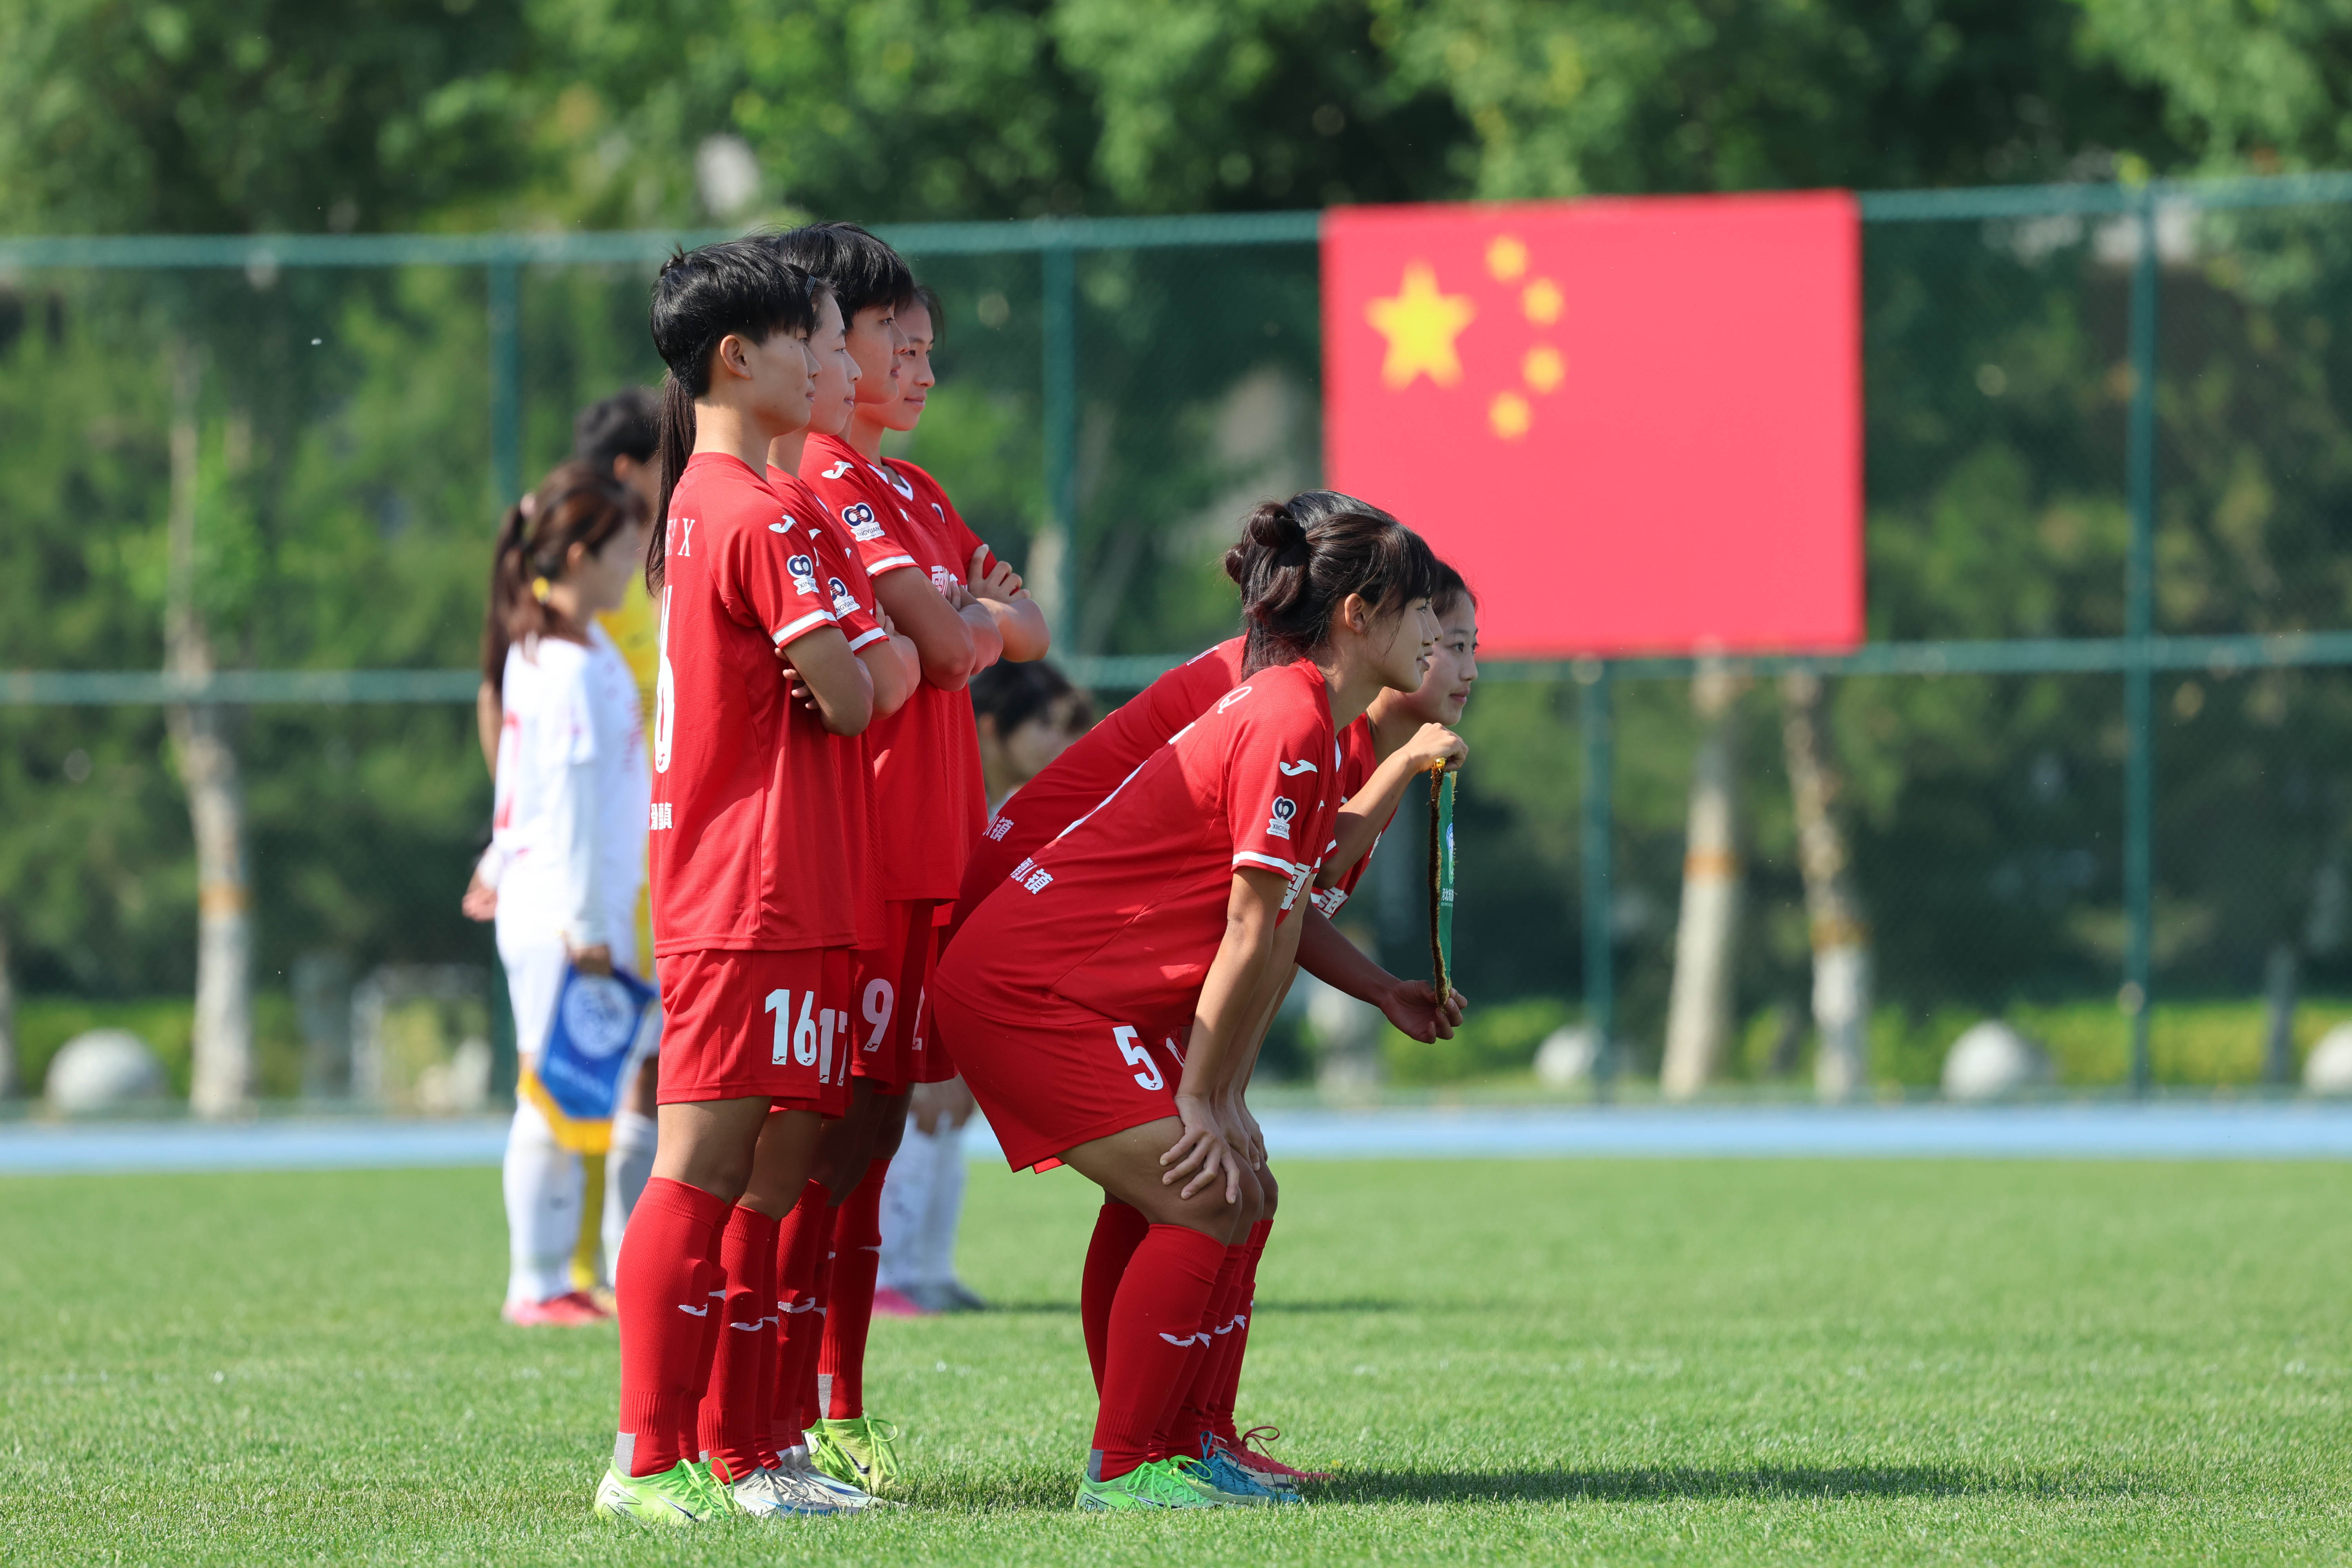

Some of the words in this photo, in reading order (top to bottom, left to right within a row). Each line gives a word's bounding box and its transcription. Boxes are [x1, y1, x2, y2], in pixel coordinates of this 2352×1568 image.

[765, 989, 817, 1066] 16
[862, 978, 894, 1052] 9
[1112, 1025, 1164, 1091] 5
